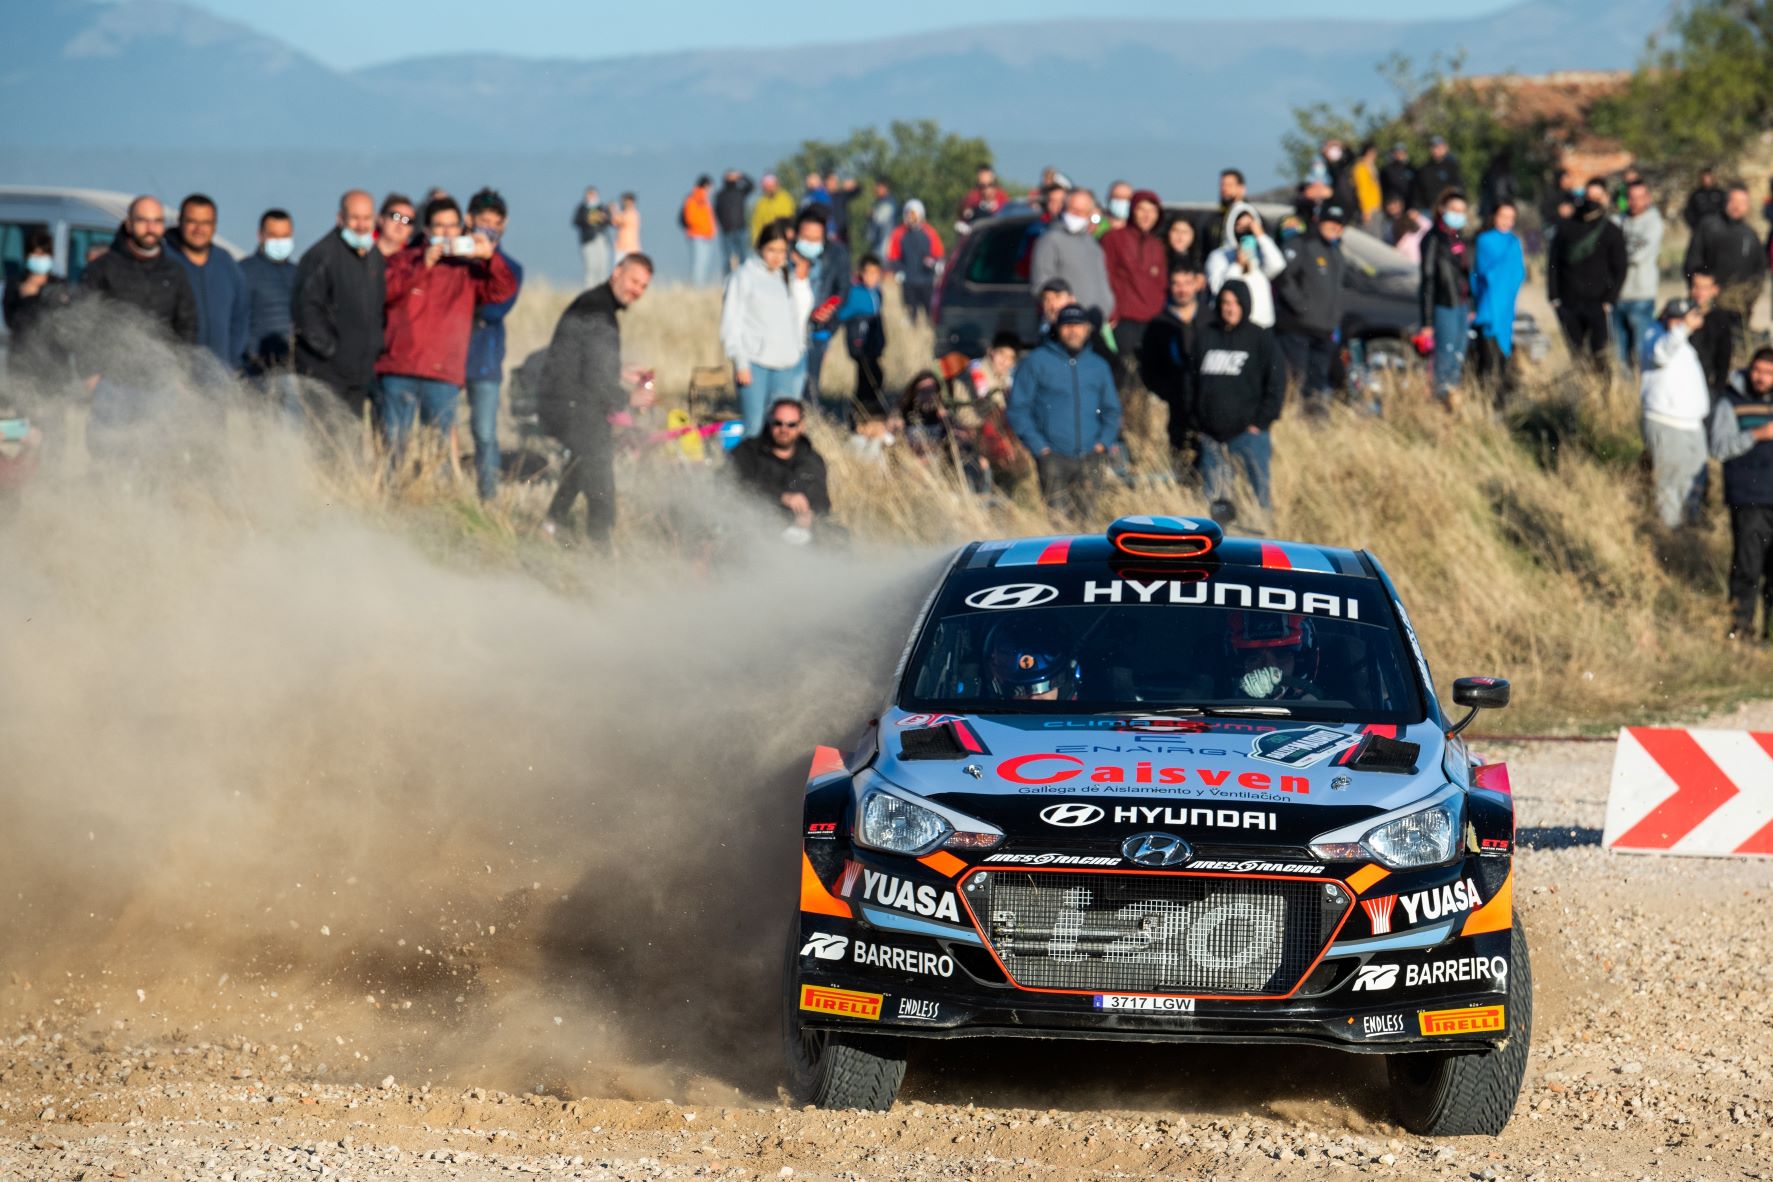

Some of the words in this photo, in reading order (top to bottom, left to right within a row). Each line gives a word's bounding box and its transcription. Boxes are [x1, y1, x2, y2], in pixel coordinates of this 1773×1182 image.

[1083, 580, 1359, 620] HYUNDAI
[1018, 785, 1076, 794] Gallega
[1081, 785, 1100, 793] de
[1103, 785, 1191, 795] Aislamiento
[1209, 788, 1291, 802] Ventilación
[809, 823, 837, 831] ETS
[1114, 806, 1277, 830] HYUNDAI
[1481, 839, 1509, 848] ETS
[1052, 856, 1122, 866] RACING
[1256, 862, 1325, 874] RACING
[863, 868, 960, 922] YUASA
[1399, 877, 1482, 924] YUASA
[854, 940, 954, 978] BARREIRO
[1405, 956, 1508, 987] BARREIRO
[805, 988, 880, 1015] PIRELLI
[898, 998, 940, 1018] ENDLESS
[1111, 996, 1148, 1008] 3717
[1153, 998, 1191, 1010] LGW
[1363, 1014, 1404, 1033] ENDLESS
[1424, 1009, 1499, 1033] PIRELLI
